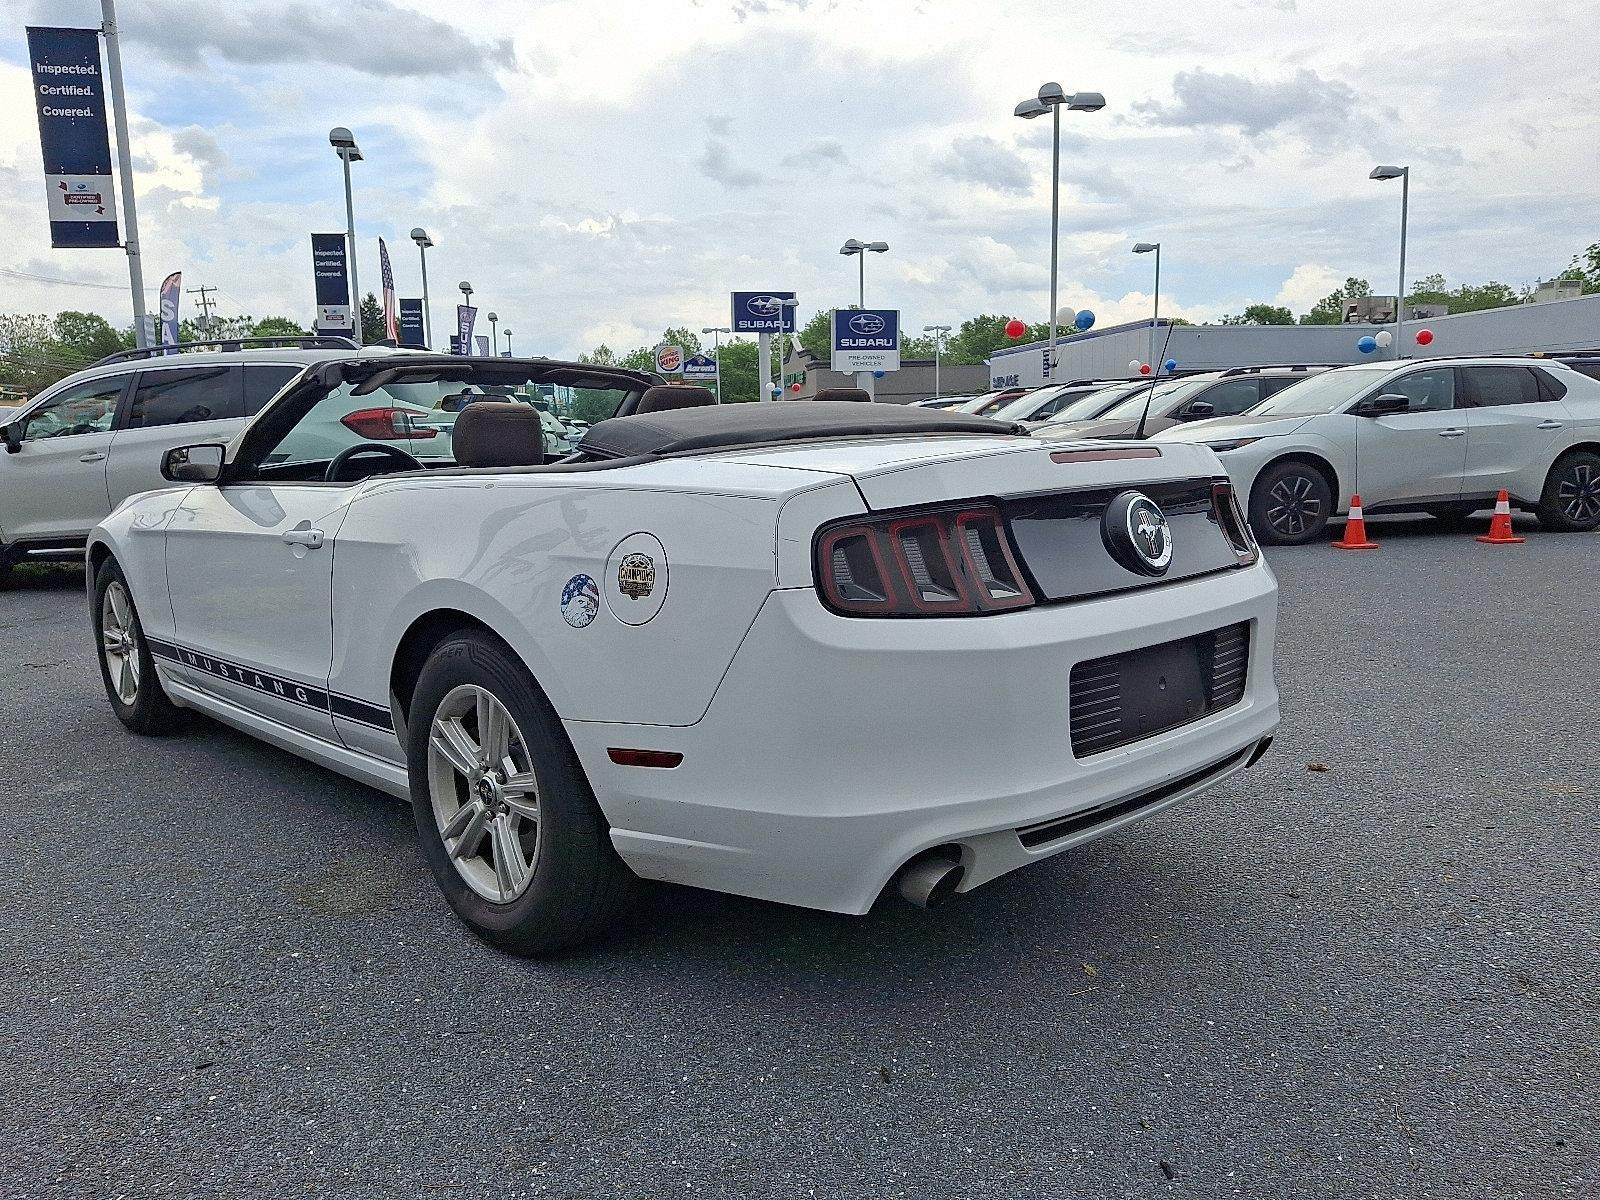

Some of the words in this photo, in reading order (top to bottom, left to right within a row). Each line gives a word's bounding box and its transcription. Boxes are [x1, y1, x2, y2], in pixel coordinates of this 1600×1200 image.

[37, 63, 98, 75] Inspected.
[40, 84, 94, 95] Certified.
[42, 105, 94, 116] Covered.
[315, 249, 344, 257] Inspected.
[738, 320, 791, 329] SUBARU
[840, 338, 893, 347] SUBARU
[660, 356, 680, 366] KING
[187, 653, 308, 702] MUSTANG
